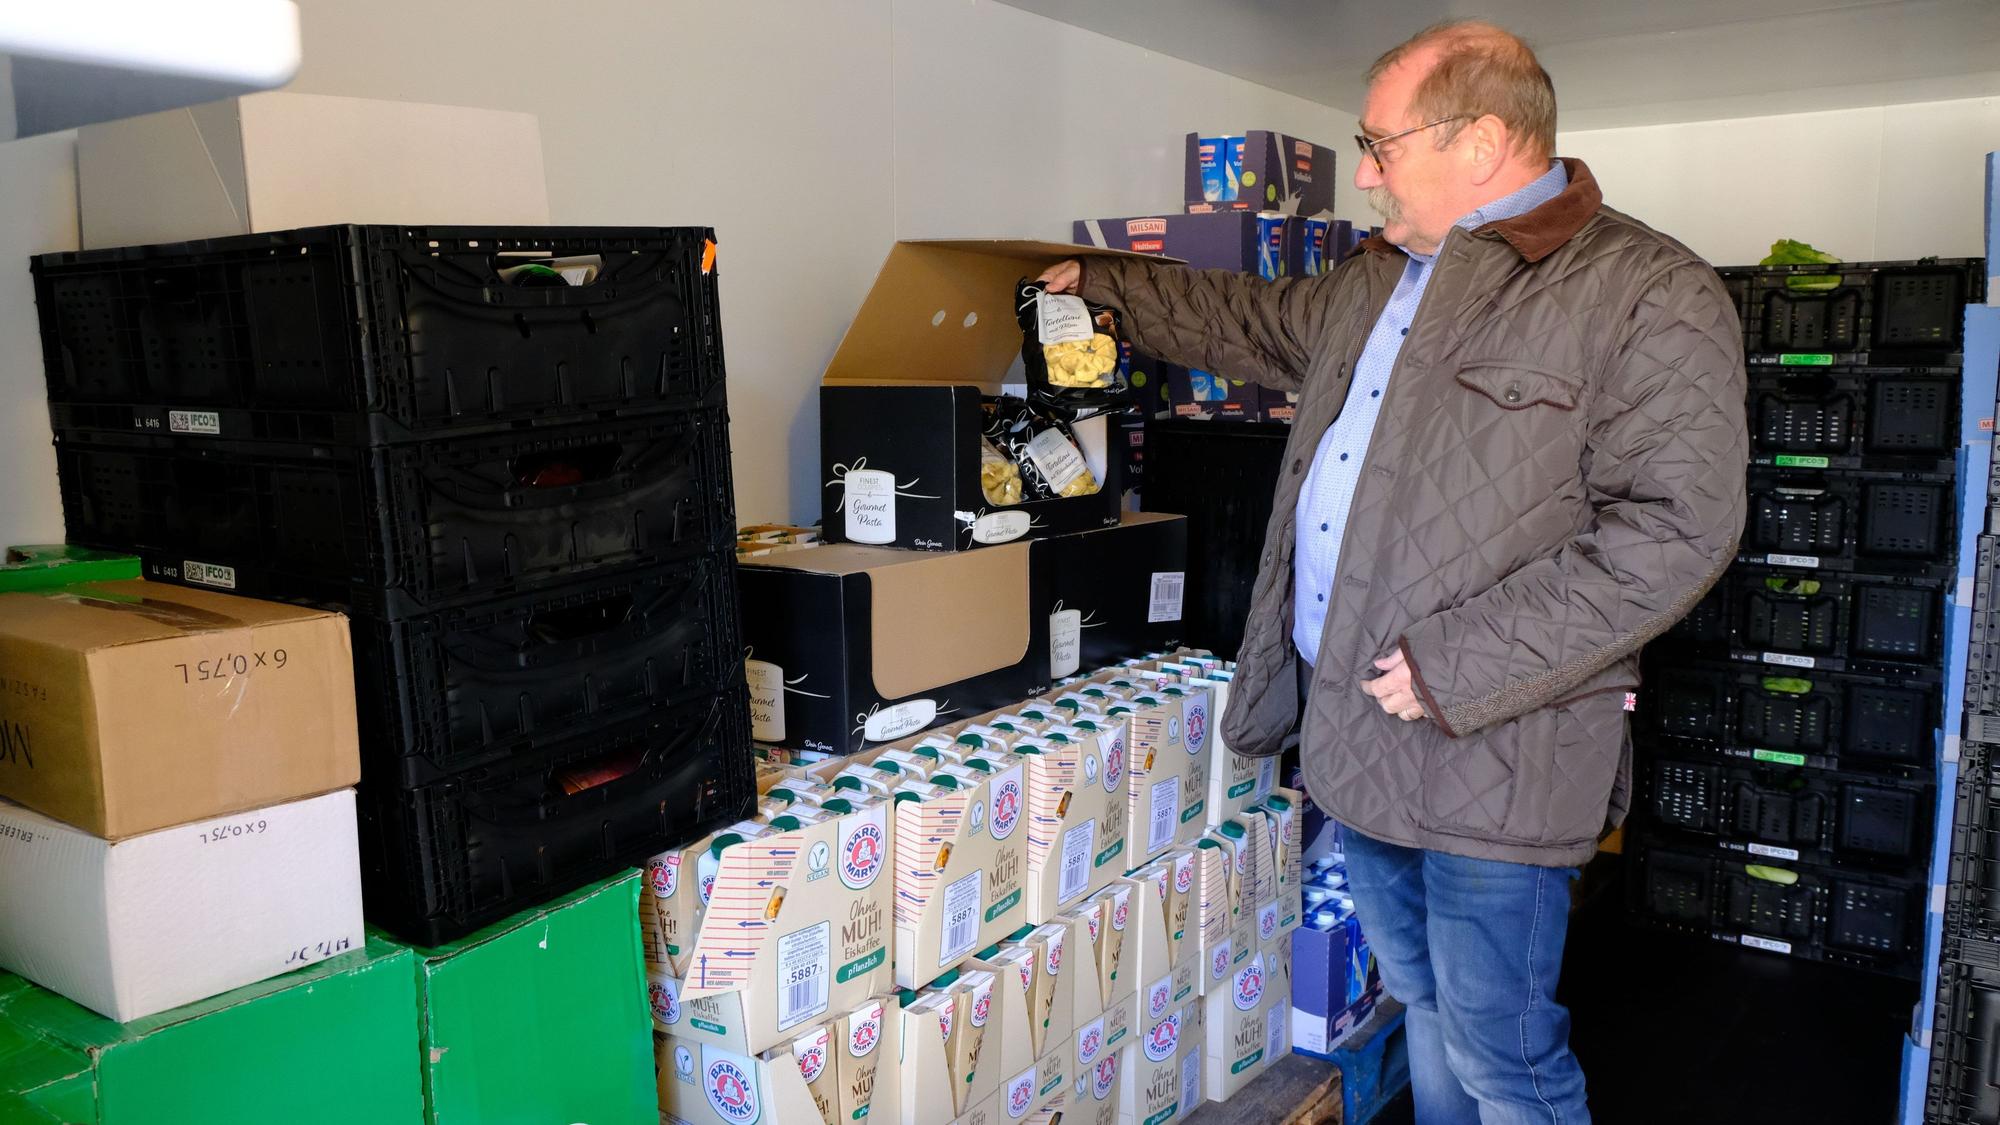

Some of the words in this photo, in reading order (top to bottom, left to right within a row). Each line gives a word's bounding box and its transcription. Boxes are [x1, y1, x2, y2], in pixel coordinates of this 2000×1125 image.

[1130, 222, 1163, 233] MILSANI
[190, 414, 208, 426] IFCO
[853, 499, 887, 515] Gourmet
[857, 514, 882, 527] Pasta
[205, 565, 224, 579] IFCO
[1052, 638, 1075, 653] Gourmet
[198, 653, 247, 680] 0,75
[254, 651, 267, 667] x
[274, 649, 287, 669] 6
[174, 663, 188, 684] L
[880, 722, 904, 738] Gourmet
[995, 783, 1019, 808] BÄREN
[994, 805, 1019, 830] MARKE
[1157, 807, 1172, 820] 5887
[212, 825, 242, 841] 0,75
[258, 820, 267, 833] 6
[200, 834, 207, 843] L
[846, 827, 881, 853] BÄREN
[845, 852, 881, 878] MARKE
[995, 845, 1016, 867] Ohne
[1068, 852, 1085, 868] 5887
[989, 855, 1019, 891] MUH!
[990, 880, 1017, 902] Eiskaffee
[850, 896, 877, 921] Ohne
[951, 907, 972, 926] 5887
[841, 909, 882, 947] MUH!
[845, 937, 880, 960] Eiskaffee
[791, 964, 818, 983] 5887
[848, 956, 878, 979] pflanzlich
[690, 999, 720, 1015] MUH!
[1150, 1032, 1178, 1053] MARKE
[1234, 1023, 1263, 1048] MUH!
[711, 1063, 750, 1092] BÄREN
[1152, 1066, 1174, 1085] Ohne
[1146, 1073, 1178, 1104] MUH!
[712, 1089, 752, 1116] MARKE
